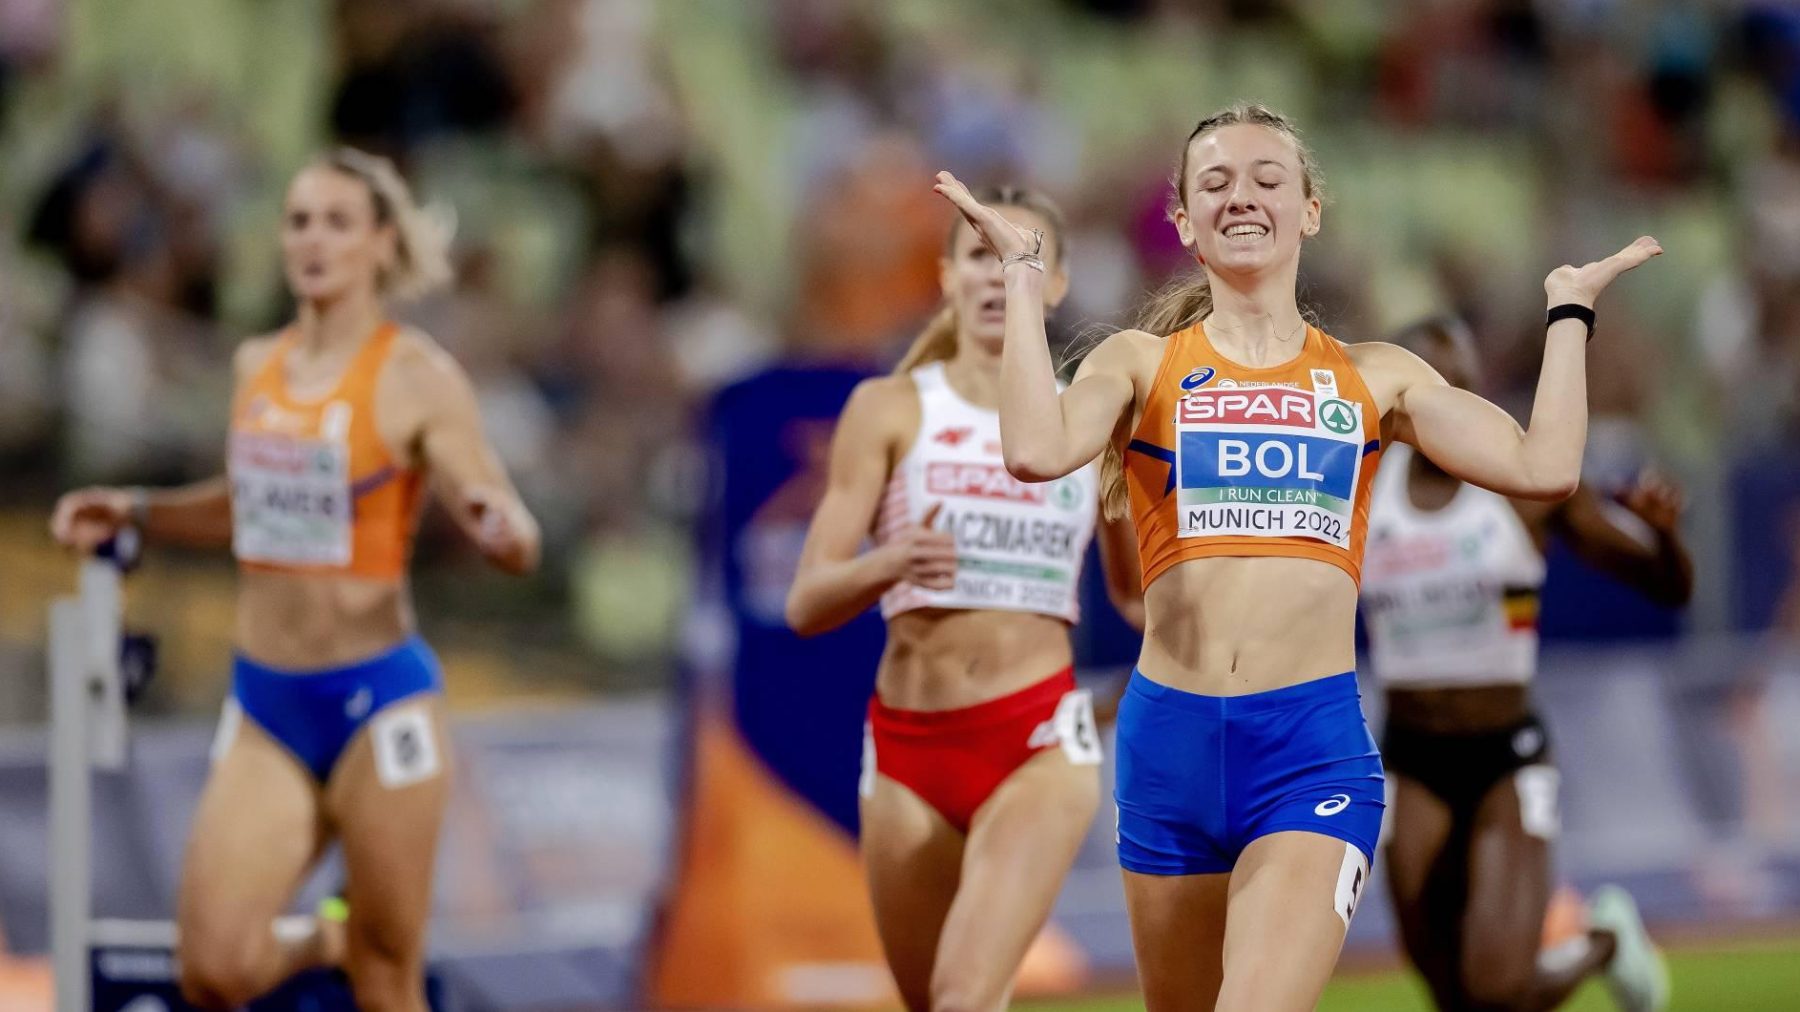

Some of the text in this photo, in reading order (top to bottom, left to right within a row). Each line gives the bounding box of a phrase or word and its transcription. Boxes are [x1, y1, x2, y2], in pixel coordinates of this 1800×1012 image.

[1184, 393, 1312, 423] SPAR
[1218, 438, 1325, 482] BOL
[1228, 488, 1261, 502] RUN
[944, 510, 1077, 559] ACZMAREK
[1188, 508, 1342, 541] MUNICH 2022
